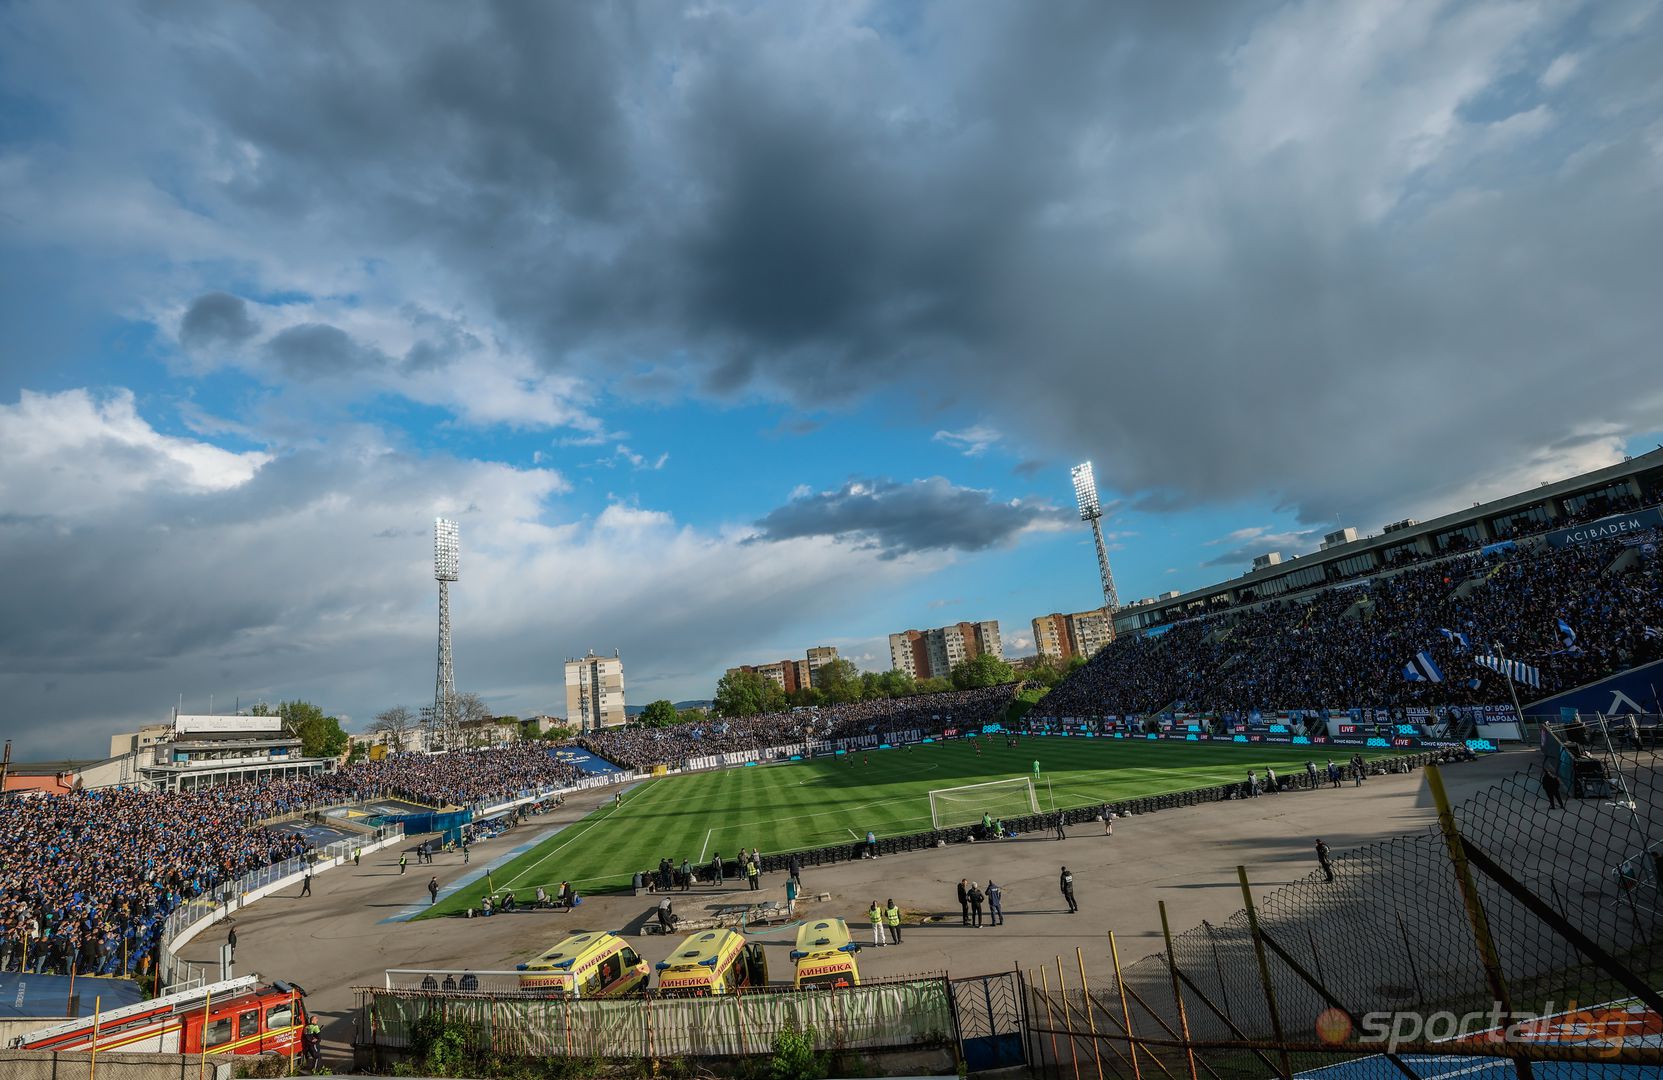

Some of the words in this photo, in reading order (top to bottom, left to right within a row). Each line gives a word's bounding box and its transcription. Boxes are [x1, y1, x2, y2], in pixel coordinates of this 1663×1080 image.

[1566, 520, 1640, 543] ACIBADEM
[689, 755, 717, 770] НИТО
[577, 775, 609, 790] СИРАКОВ
[614, 772, 633, 783] ВЪН!
[661, 977, 710, 987] ЛИНЕЙКА
